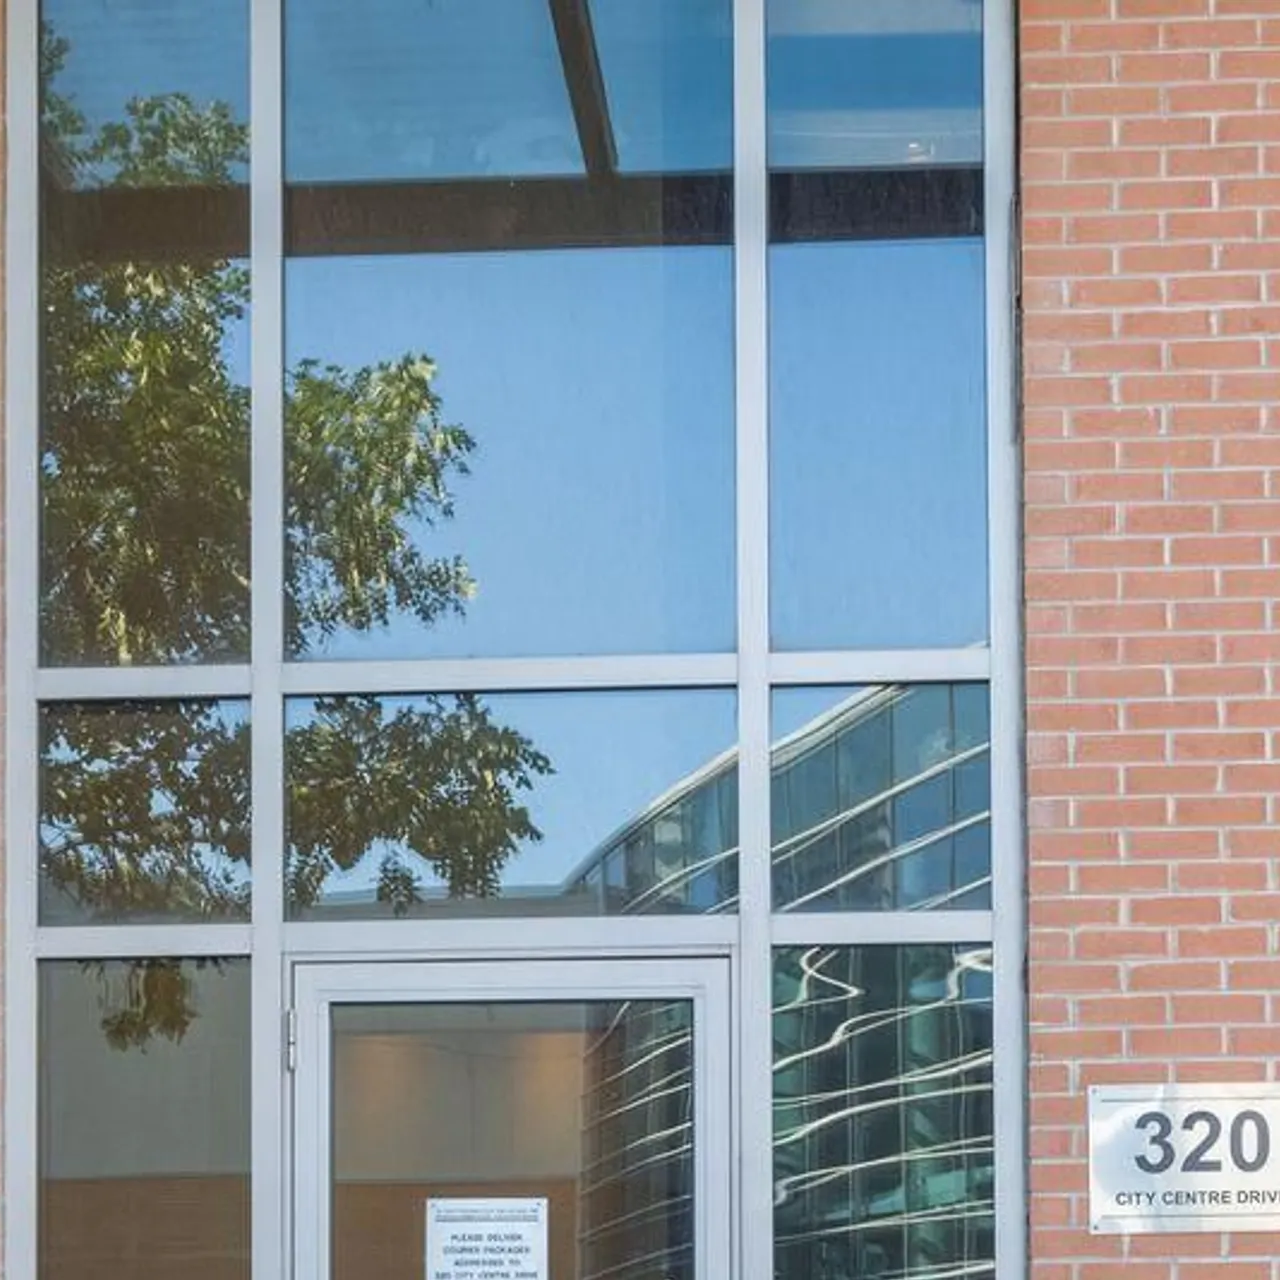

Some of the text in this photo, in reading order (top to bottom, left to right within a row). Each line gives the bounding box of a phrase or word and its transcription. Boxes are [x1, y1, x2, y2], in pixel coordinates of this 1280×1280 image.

[1134, 1109, 1270, 1174] 320
[1115, 1191, 1157, 1206] CITY
[1161, 1190, 1231, 1206] CENTRE
[451, 1233, 523, 1242] PLEASE DELIVER
